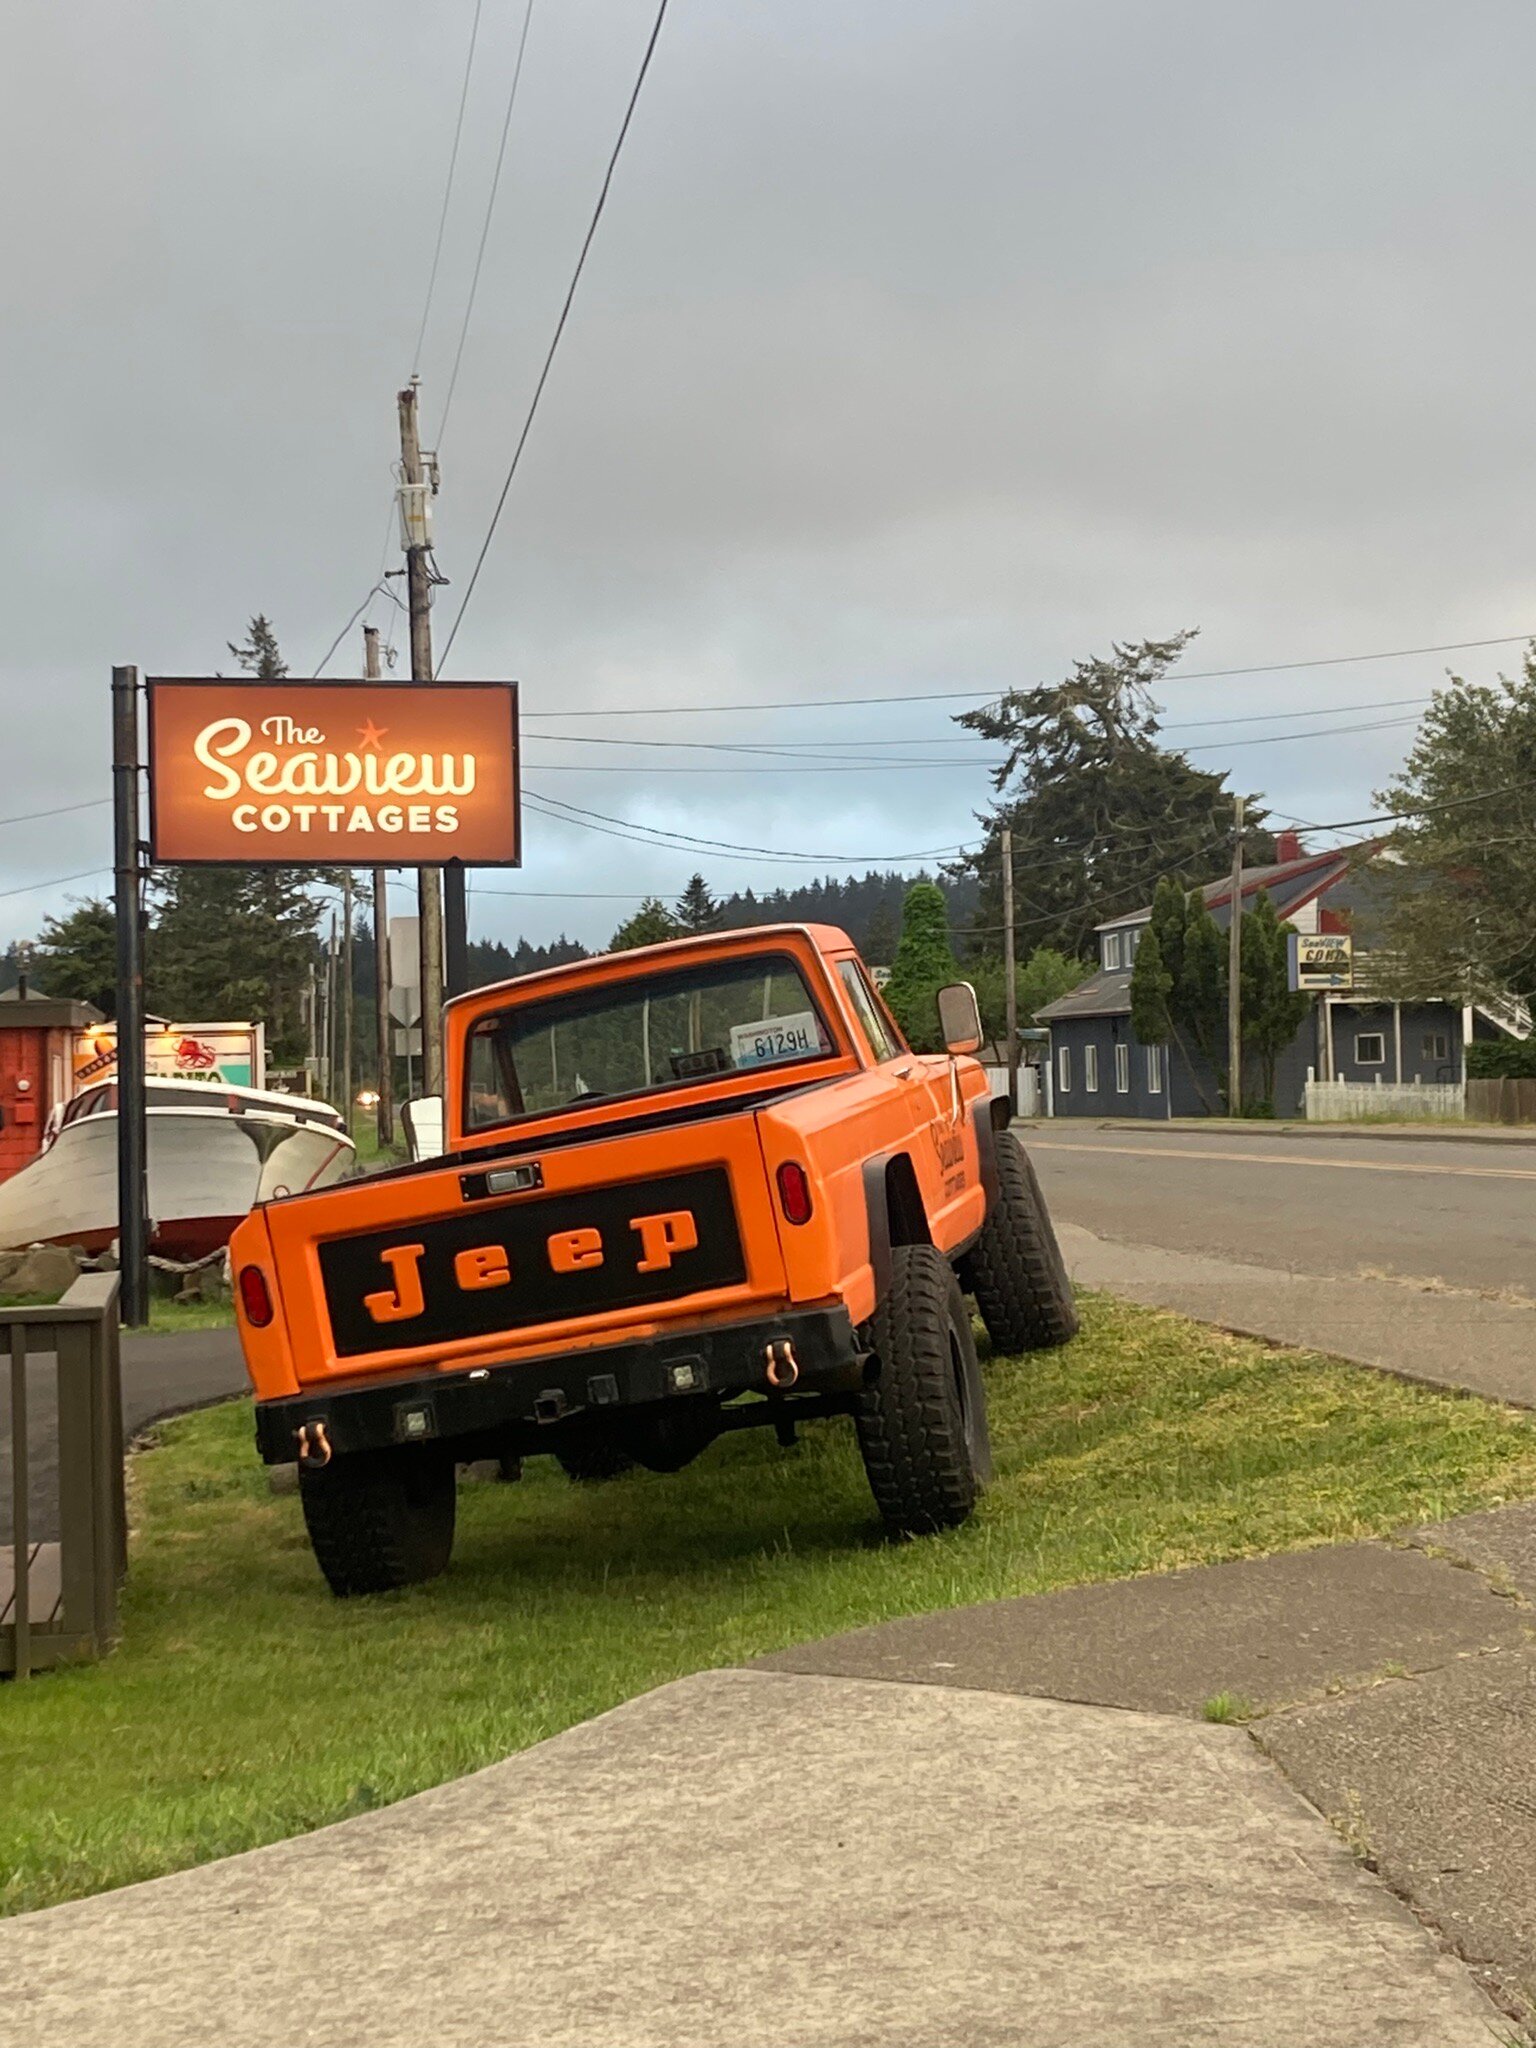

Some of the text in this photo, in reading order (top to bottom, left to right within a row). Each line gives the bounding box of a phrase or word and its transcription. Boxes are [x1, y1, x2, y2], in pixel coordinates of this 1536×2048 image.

[261, 716, 326, 745] The
[194, 717, 476, 800] Seaview
[231, 804, 459, 833] COTTAGES
[754, 1028, 809, 1058] 6129H
[363, 1210, 699, 1324] Jeep
